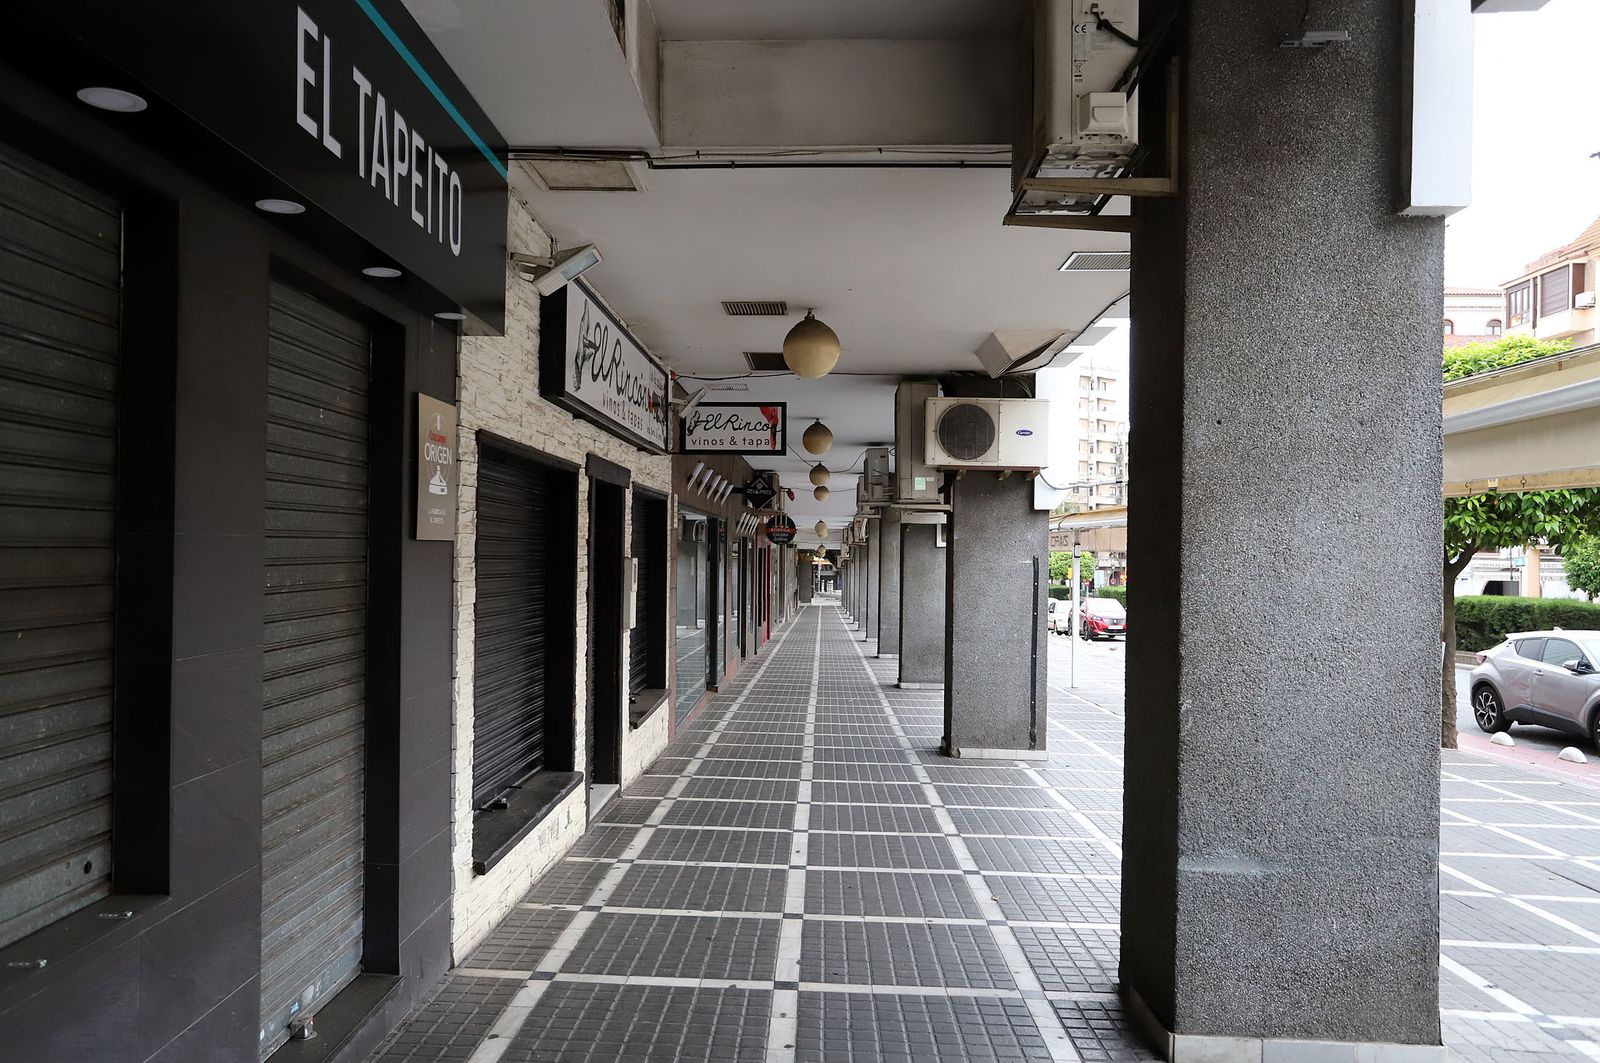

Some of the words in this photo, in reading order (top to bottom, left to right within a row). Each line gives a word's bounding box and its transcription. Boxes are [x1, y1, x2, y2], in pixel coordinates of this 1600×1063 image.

[297, 6, 342, 159] EL
[353, 65, 462, 257] TAPEITO
[591, 321, 611, 383] El
[602, 391, 620, 417] vinos
[627, 409, 643, 432] tapas
[704, 413, 722, 431] El
[424, 442, 453, 465] ORIGEN
[691, 437, 724, 446] vinos
[729, 436, 738, 446] &
